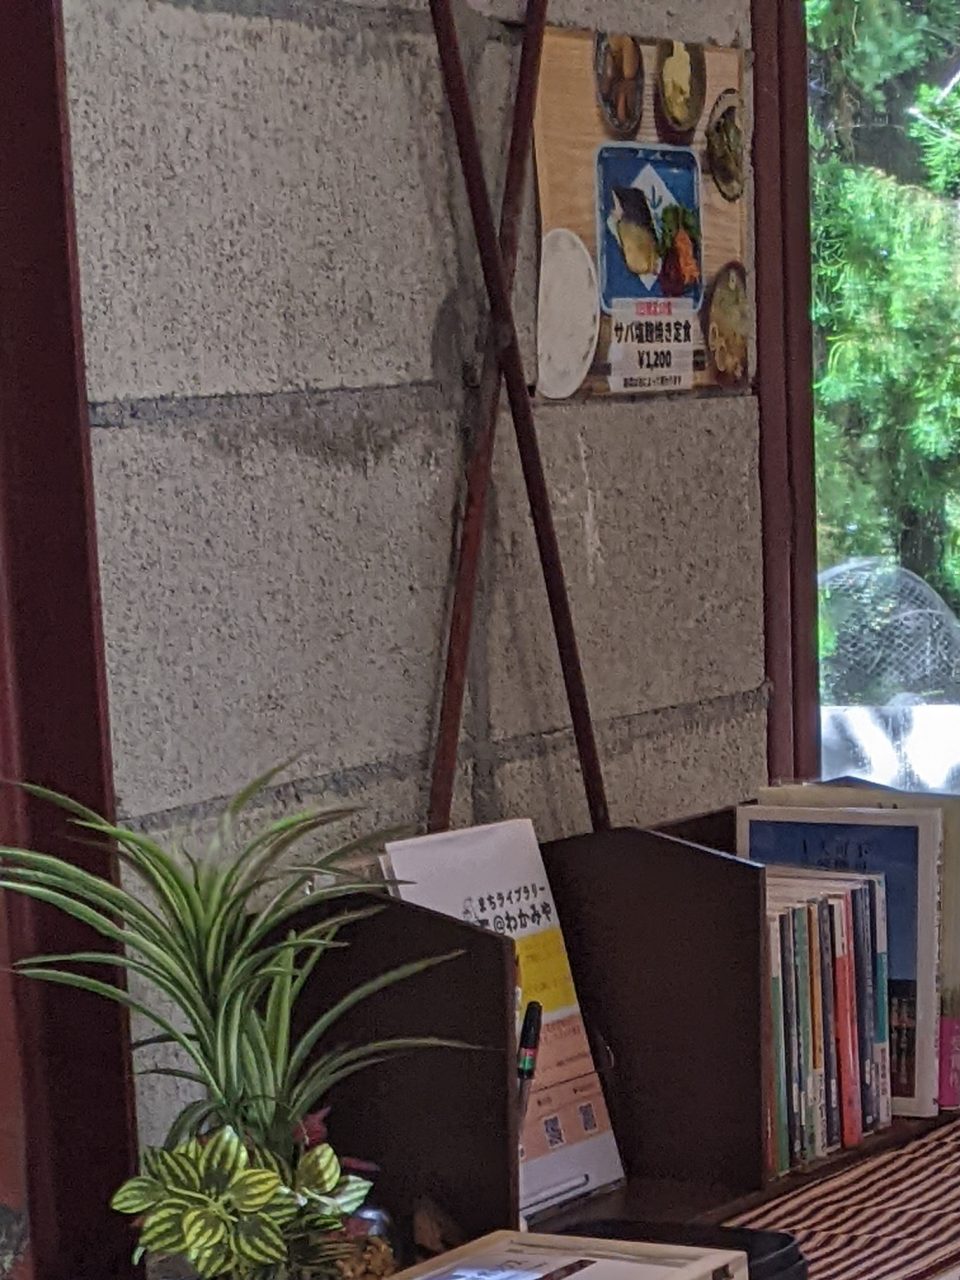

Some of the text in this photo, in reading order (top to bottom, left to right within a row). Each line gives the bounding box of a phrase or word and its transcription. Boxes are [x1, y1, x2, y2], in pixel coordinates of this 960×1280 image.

[637, 349, 672, 371] ¥1,200
[478, 883, 545, 913] まちライブラリー
[493, 901, 552, 935] @わかみや
